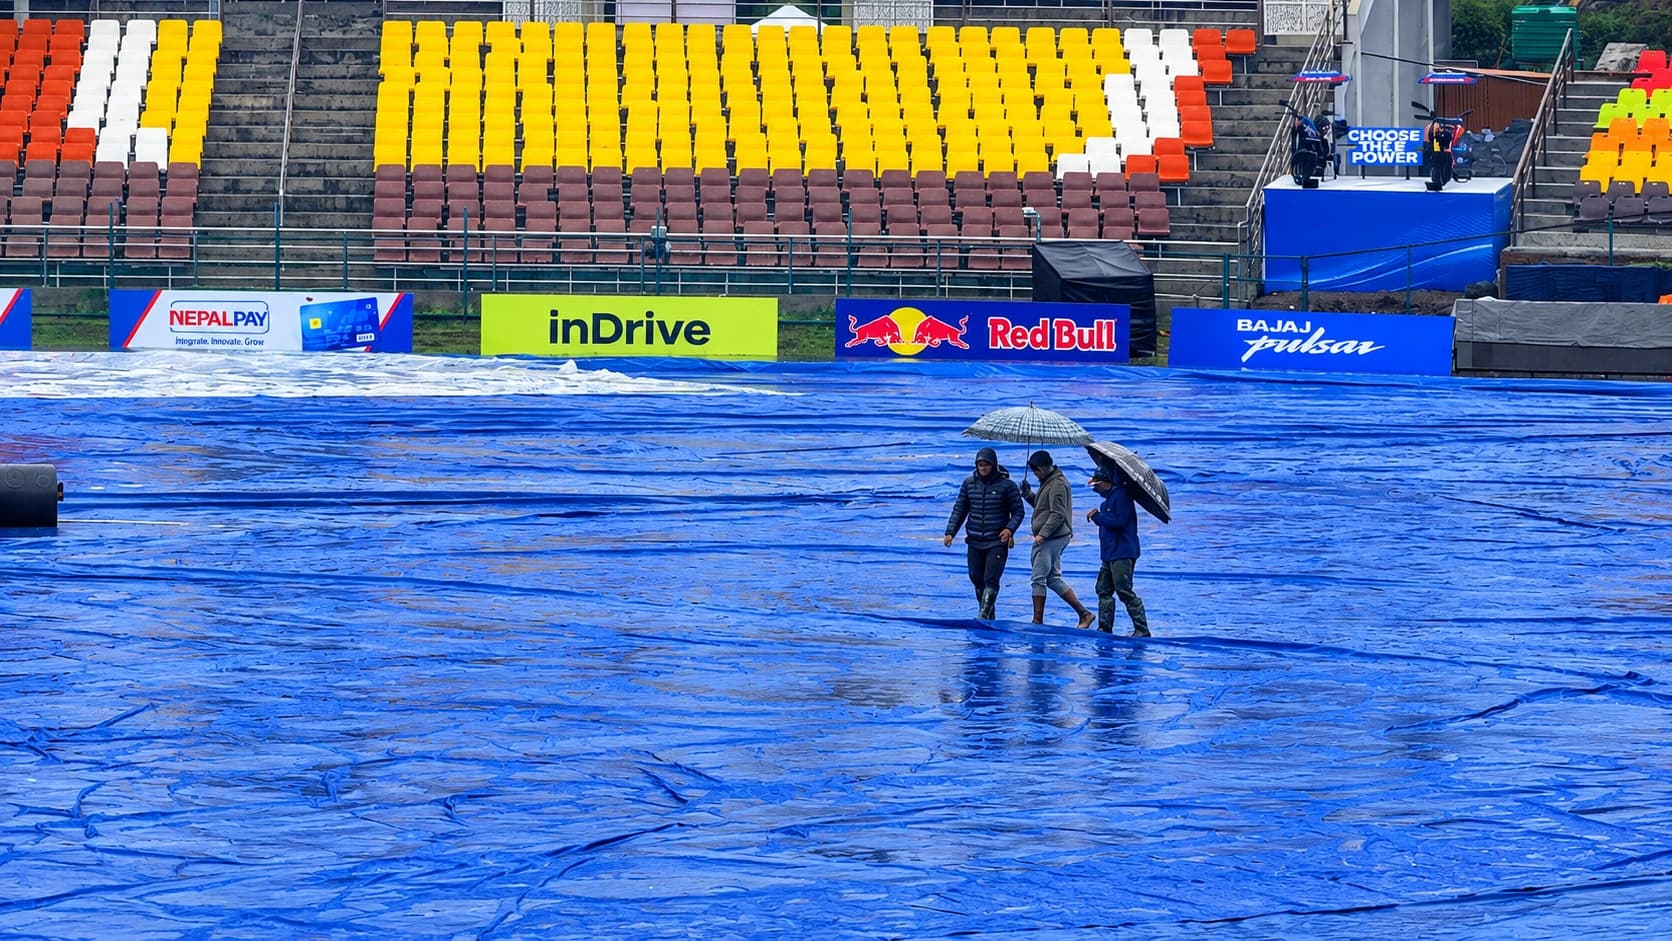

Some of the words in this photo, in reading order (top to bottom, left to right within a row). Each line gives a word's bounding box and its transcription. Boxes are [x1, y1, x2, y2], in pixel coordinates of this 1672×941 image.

[1348, 129, 1421, 142] CHOOSE
[1352, 151, 1418, 164] POWER
[169, 310, 267, 327] NEPALPAY
[1236, 318, 1311, 334] BAJAJ
[549, 309, 711, 345] inDrive
[989, 317, 1049, 350] Red
[1054, 318, 1116, 352] Bull
[244, 336, 265, 346] Grow
[1240, 327, 1386, 363] pulsar
